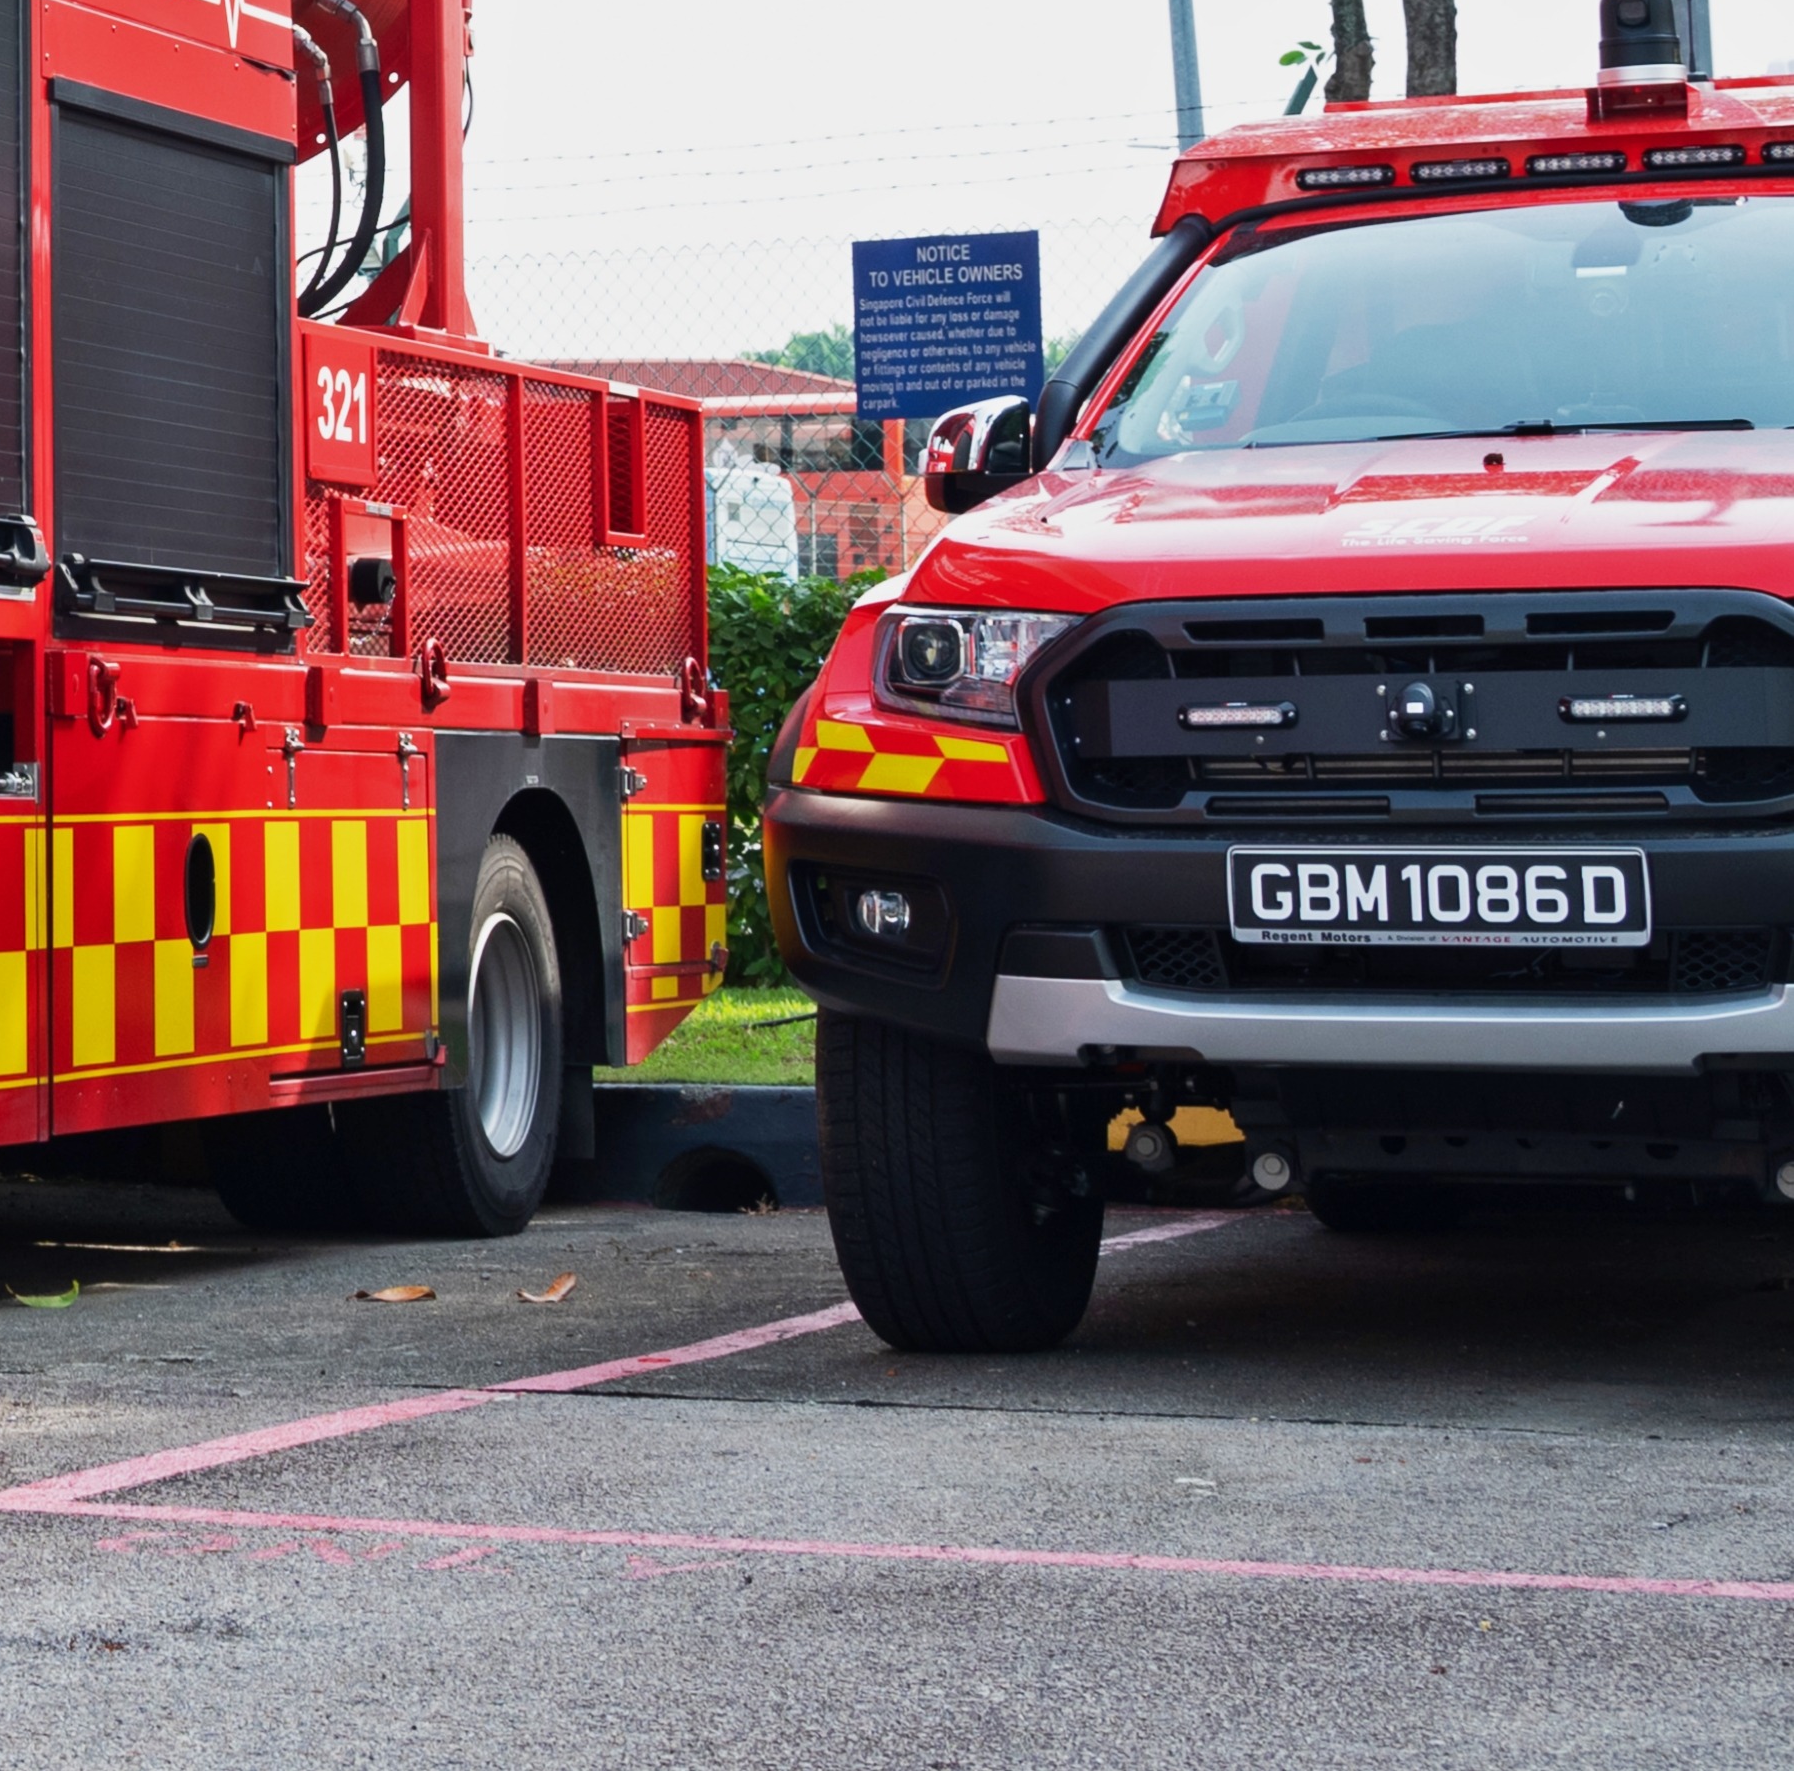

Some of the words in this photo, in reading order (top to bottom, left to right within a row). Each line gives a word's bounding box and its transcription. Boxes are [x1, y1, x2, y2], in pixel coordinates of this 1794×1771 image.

[917, 244, 971, 263] NOTICE
[869, 271, 888, 288] TO
[892, 268, 954, 287] VEHICLE
[958, 264, 1023, 283] OWNERS
[859, 297, 904, 313] Singapore
[906, 295, 926, 308] Civil
[927, 293, 964, 307] Defence
[966, 292, 993, 305] Force
[995, 290, 1011, 304] will
[859, 315, 875, 327] not
[876, 314, 888, 326] be
[889, 313, 912, 326] liable
[915, 312, 929, 324] for
[930, 312, 947, 329] any
[949, 311, 969, 323] loss
[971, 311, 981, 321] or
[983, 308, 1020, 324] damage
[860, 331, 908, 344] howsoever
[910, 328, 945, 342] caused,
[947, 327, 984, 340] whether
[987, 326, 1004, 338] due
[1007, 325, 1016, 337] to
[860, 347, 908, 363] negligence
[910, 348, 920, 358] or
[922, 344, 971, 358] otherwise,
[973, 343, 983, 355] to
[985, 344, 1001, 358] any
[1004, 340, 1036, 353] vehicle
[861, 366, 871, 376] or
[873, 363, 906, 378] fittings
[908, 364, 918, 375] or
[920, 361, 961, 374] contents
[962, 360, 973, 372] of
[975, 361, 992, 374] any
[994, 358, 1026, 371] vehicle
[862, 381, 894, 395] moving
[895, 380, 904, 391] in
[906, 379, 923, 391] and
[924, 379, 940, 391] out
[942, 378, 952, 390] of
[954, 379, 964, 389] or
[966, 376, 998, 391] parked
[1000, 376, 1009, 388] in
[1010, 375, 1026, 387] the
[317, 365, 367, 444] 321
[862, 396, 900, 413] carpark.
[1343, 515, 1539, 537] SCDF
[1341, 537, 1371, 547] The
[1377, 536, 1407, 546] Life
[1413, 534, 1473, 546] Saving
[1479, 533, 1528, 543] Force
[1250, 863, 1627, 923] GBM1086D
[1261, 930, 1313, 944] Regent
[1321, 931, 1371, 943] Motors
[1396, 934, 1425, 942] Division
[1441, 935, 1511, 944] VANTAGE
[1520, 935, 1619, 944] AUTOMOTIVE
